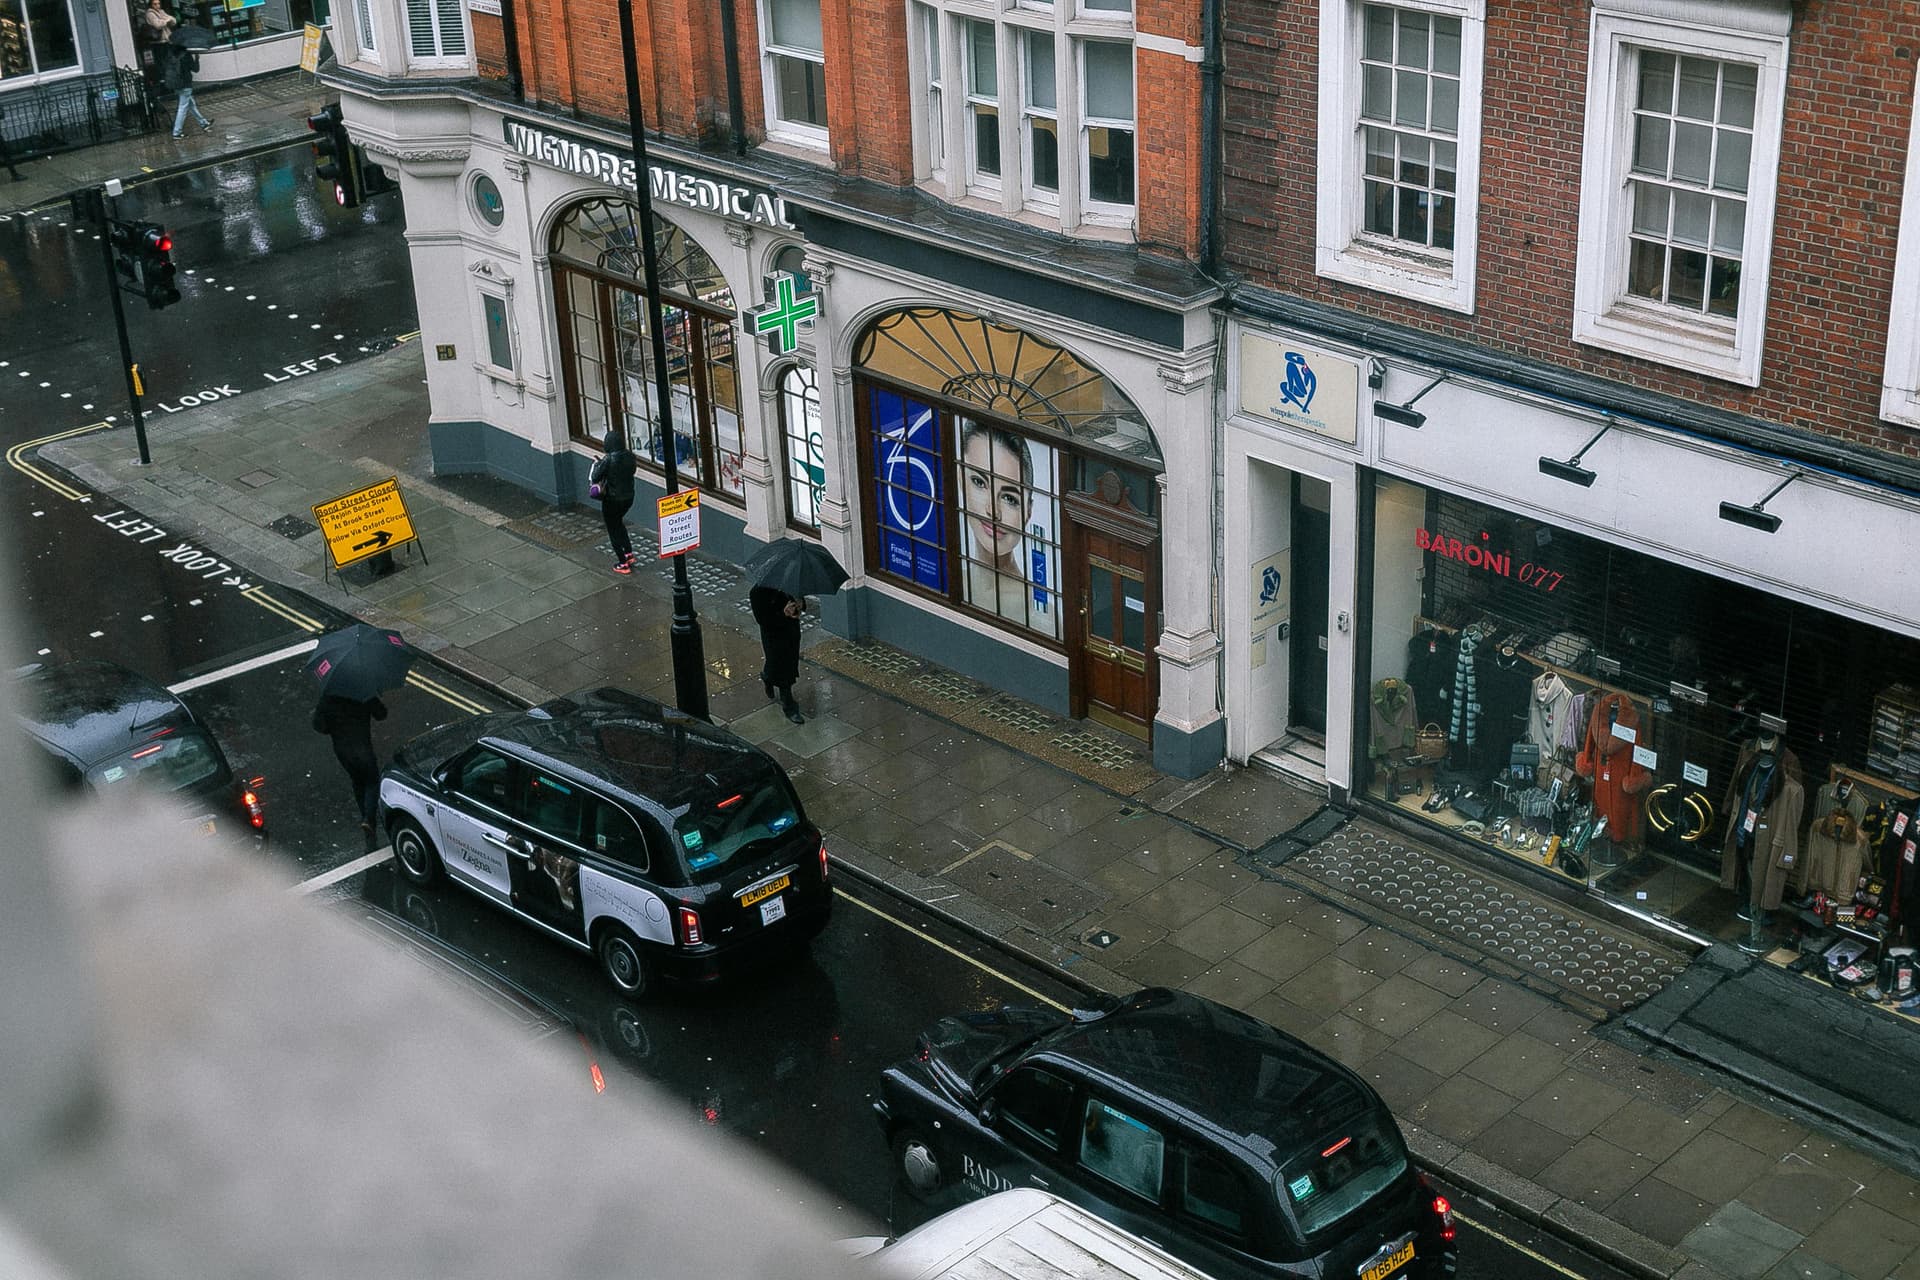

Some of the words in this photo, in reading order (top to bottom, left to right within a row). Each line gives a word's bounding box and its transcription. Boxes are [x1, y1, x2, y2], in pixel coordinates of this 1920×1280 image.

[508, 122, 638, 191] WIGMORE
[649, 166, 796, 231] MEDICAL
[158, 384, 242, 414] LOOK
[264, 352, 342, 383] LEFT
[317, 504, 338, 517] Bond
[341, 494, 366, 509] Street
[368, 484, 396, 498] Closed
[331, 510, 352, 522] Rejoin
[353, 503, 370, 514] Bond
[371, 495, 393, 506] Street
[92, 510, 167, 544] LEFT
[328, 533, 350, 545] Follow
[350, 528, 362, 536] Via
[362, 520, 385, 532] Oxford
[386, 513, 407, 524] Circus
[343, 516, 362, 527] Brook
[364, 507, 385, 519] Street
[668, 514, 692, 526] Oxford
[670, 523, 691, 534] Street
[669, 532, 693, 544] Routes
[159, 543, 231, 579] LOOK
[1518, 562, 1564, 592] 077
[461, 848, 492, 874] Zegna
